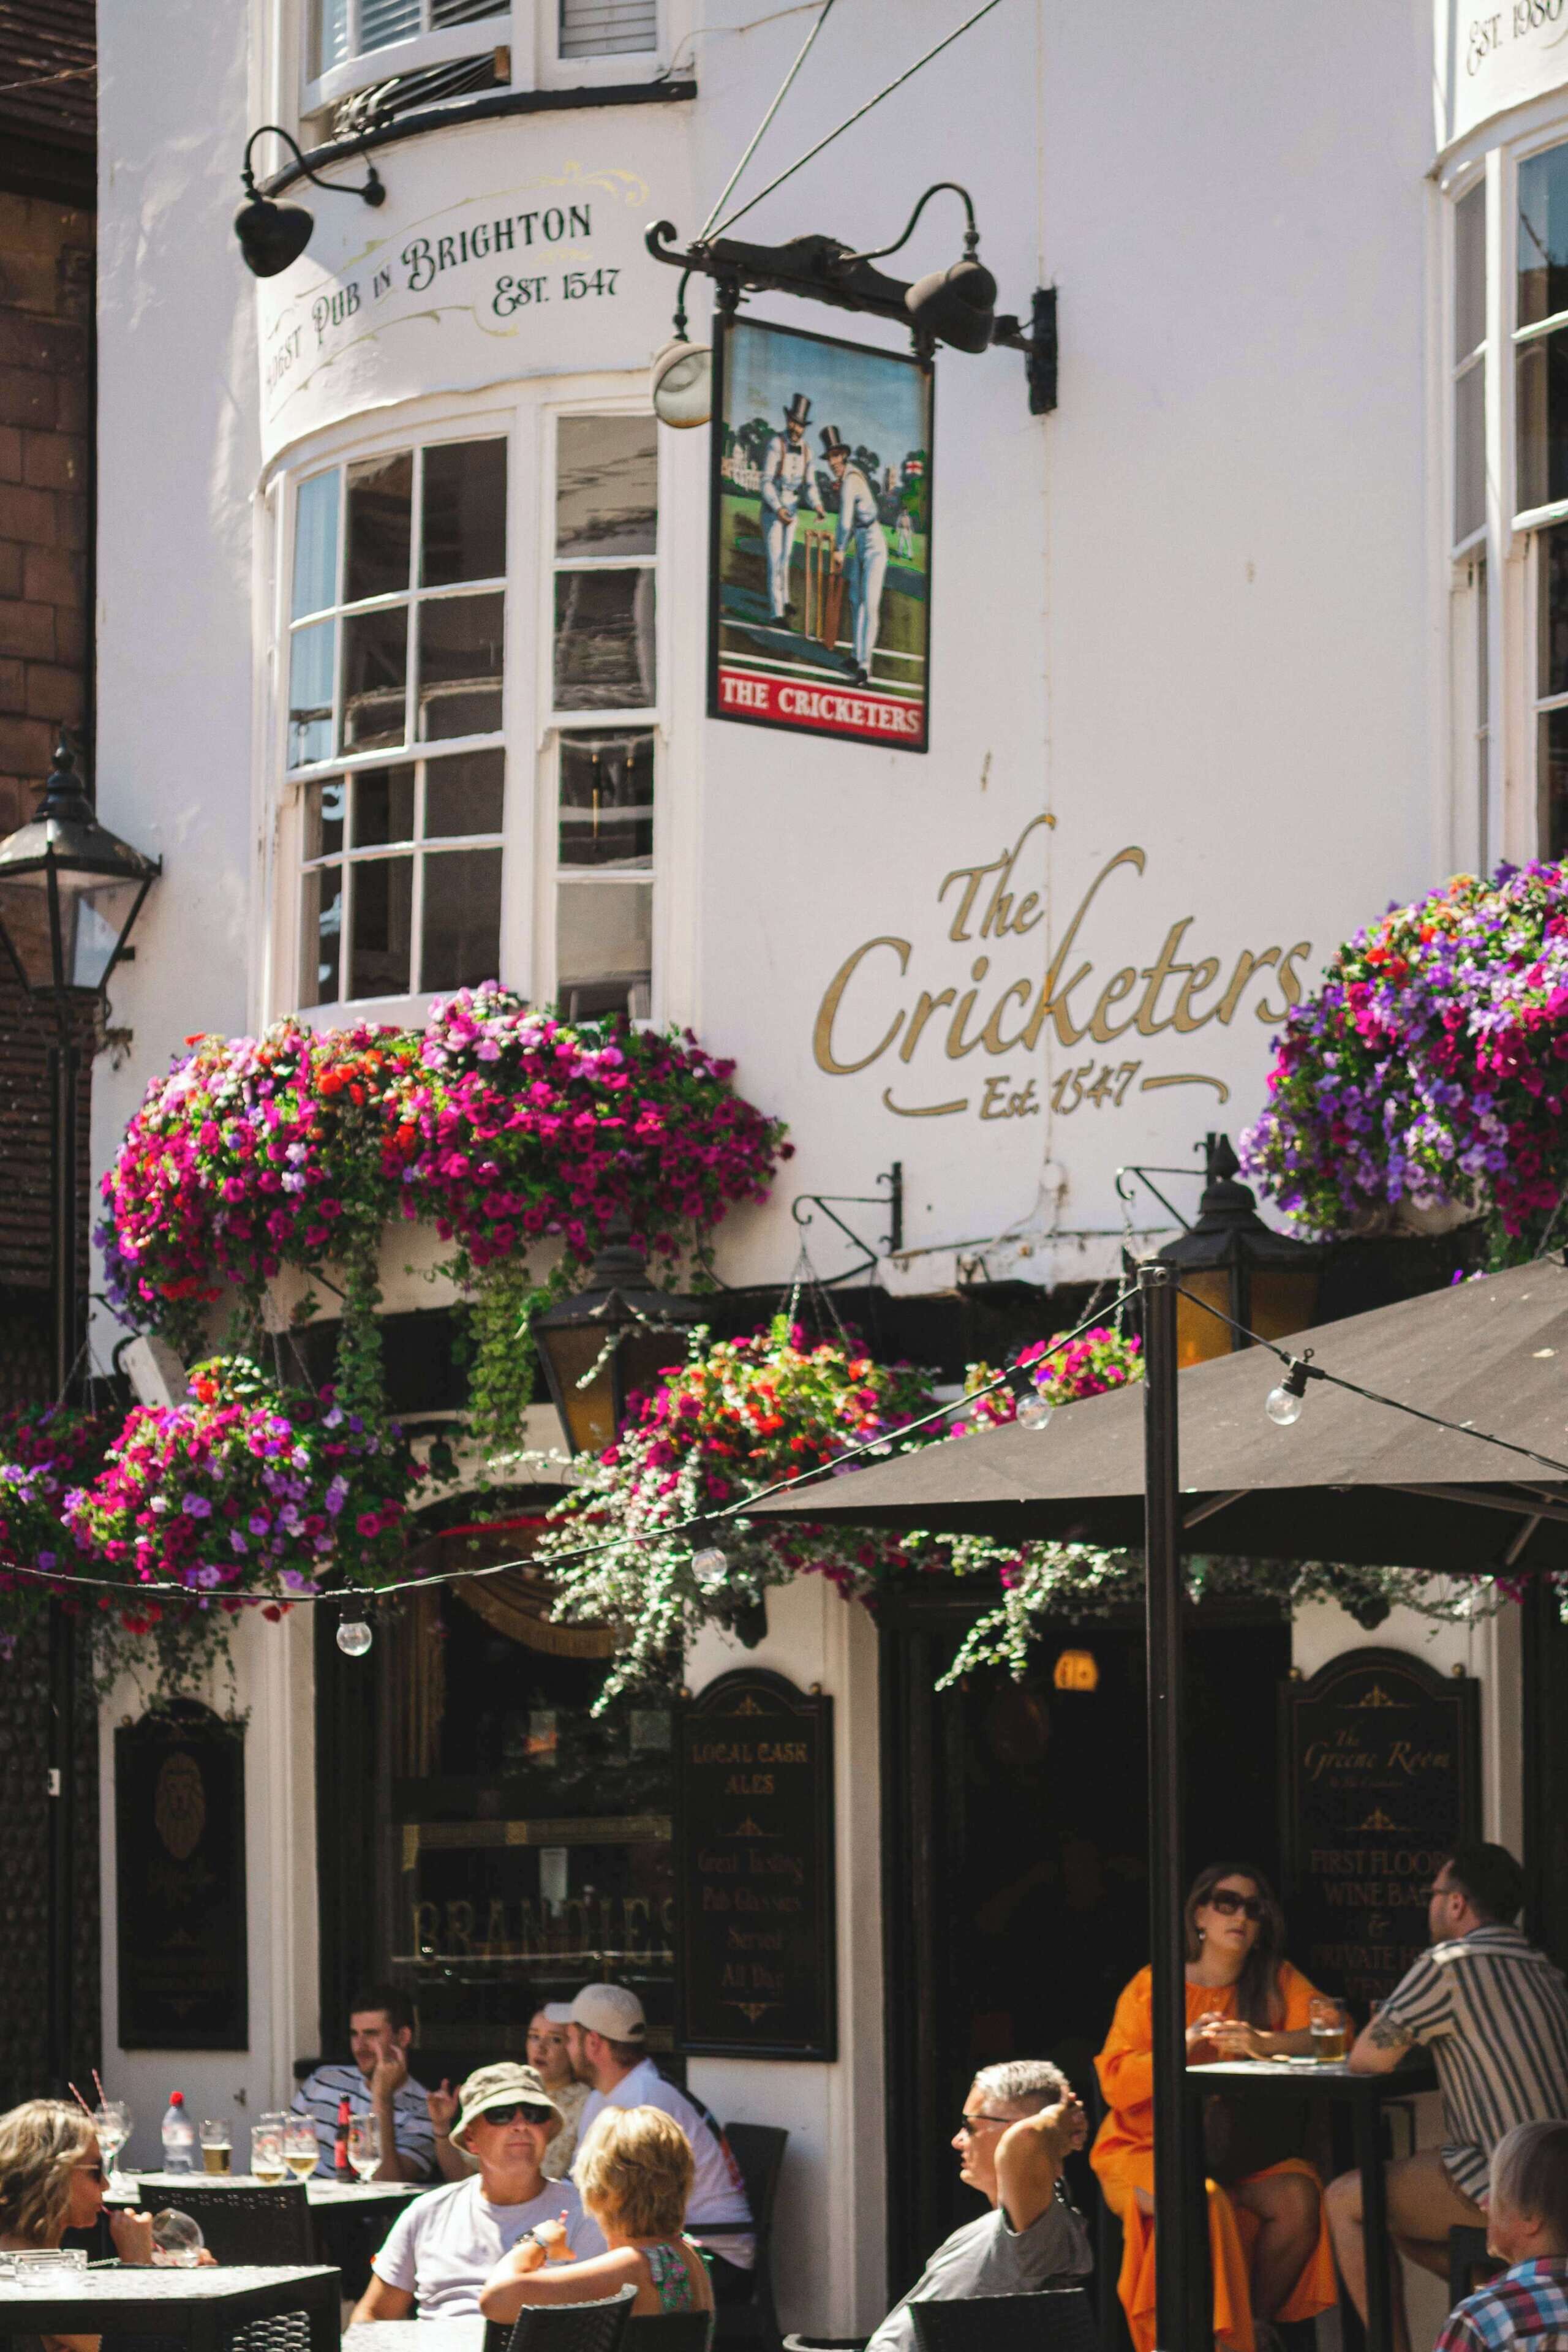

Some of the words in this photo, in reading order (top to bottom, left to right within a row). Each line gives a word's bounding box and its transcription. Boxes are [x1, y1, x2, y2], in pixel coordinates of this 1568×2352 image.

[312, 282, 361, 347] PUB
[373, 265, 391, 298] IN
[400, 204, 592, 291] BRIGHTON
[493, 275, 549, 317] EST.
[562, 268, 620, 300] 1547
[721, 677, 770, 709] THE
[778, 687, 922, 734] CRICKETERS
[938, 813, 1056, 941] The
[813, 846, 1311, 1076] Cricketers
[980, 1075, 1040, 1120] Est.
[1050, 1060, 1142, 1116] 1547
[692, 1743, 753, 1763] LOCAL
[725, 1774, 775, 1795] ALES
[1310, 1850, 1365, 1875] FIRST
[1323, 1881, 1384, 1907] WINE
